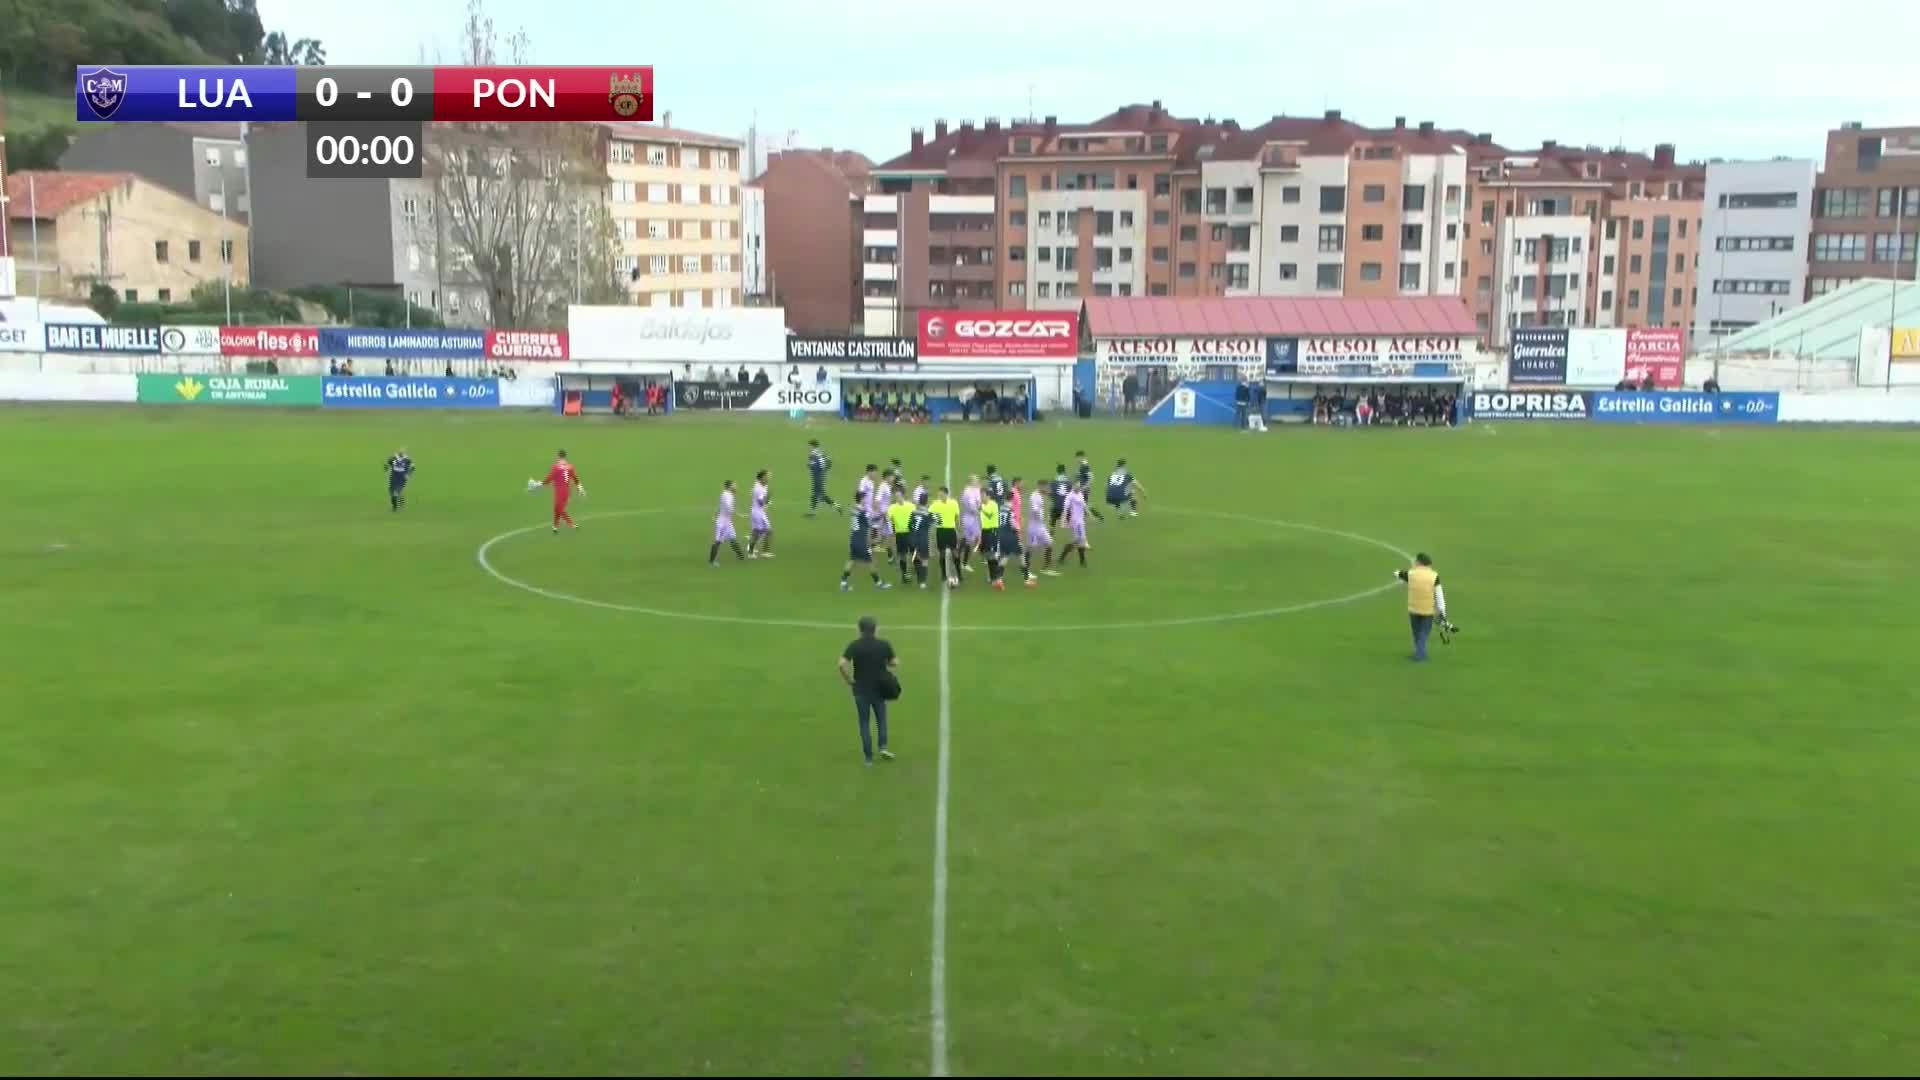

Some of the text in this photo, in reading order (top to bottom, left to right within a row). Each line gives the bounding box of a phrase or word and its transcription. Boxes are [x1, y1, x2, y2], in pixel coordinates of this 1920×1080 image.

[954, 319, 1071, 337] GOZCAR
[48, 326, 159, 349] BAR EL MUELLE
[347, 335, 483, 349] HIERROS LAMINADOS ASTURIAS
[495, 332, 558, 345] CIERRES
[491, 345, 562, 357] GUERRAS
[790, 339, 915, 358] VENTANAS CASTRILLÓN
[1514, 343, 1566, 360] Guernica
[209, 378, 289, 390] CAJA RURAL
[325, 383, 382, 398] Estrella
[385, 383, 438, 398] Galicia
[777, 389, 833, 405] SIRGO
[1474, 393, 1586, 411] BOPRISA
[1597, 397, 1655, 413] Estrella
[1659, 396, 1713, 413] Galicia
